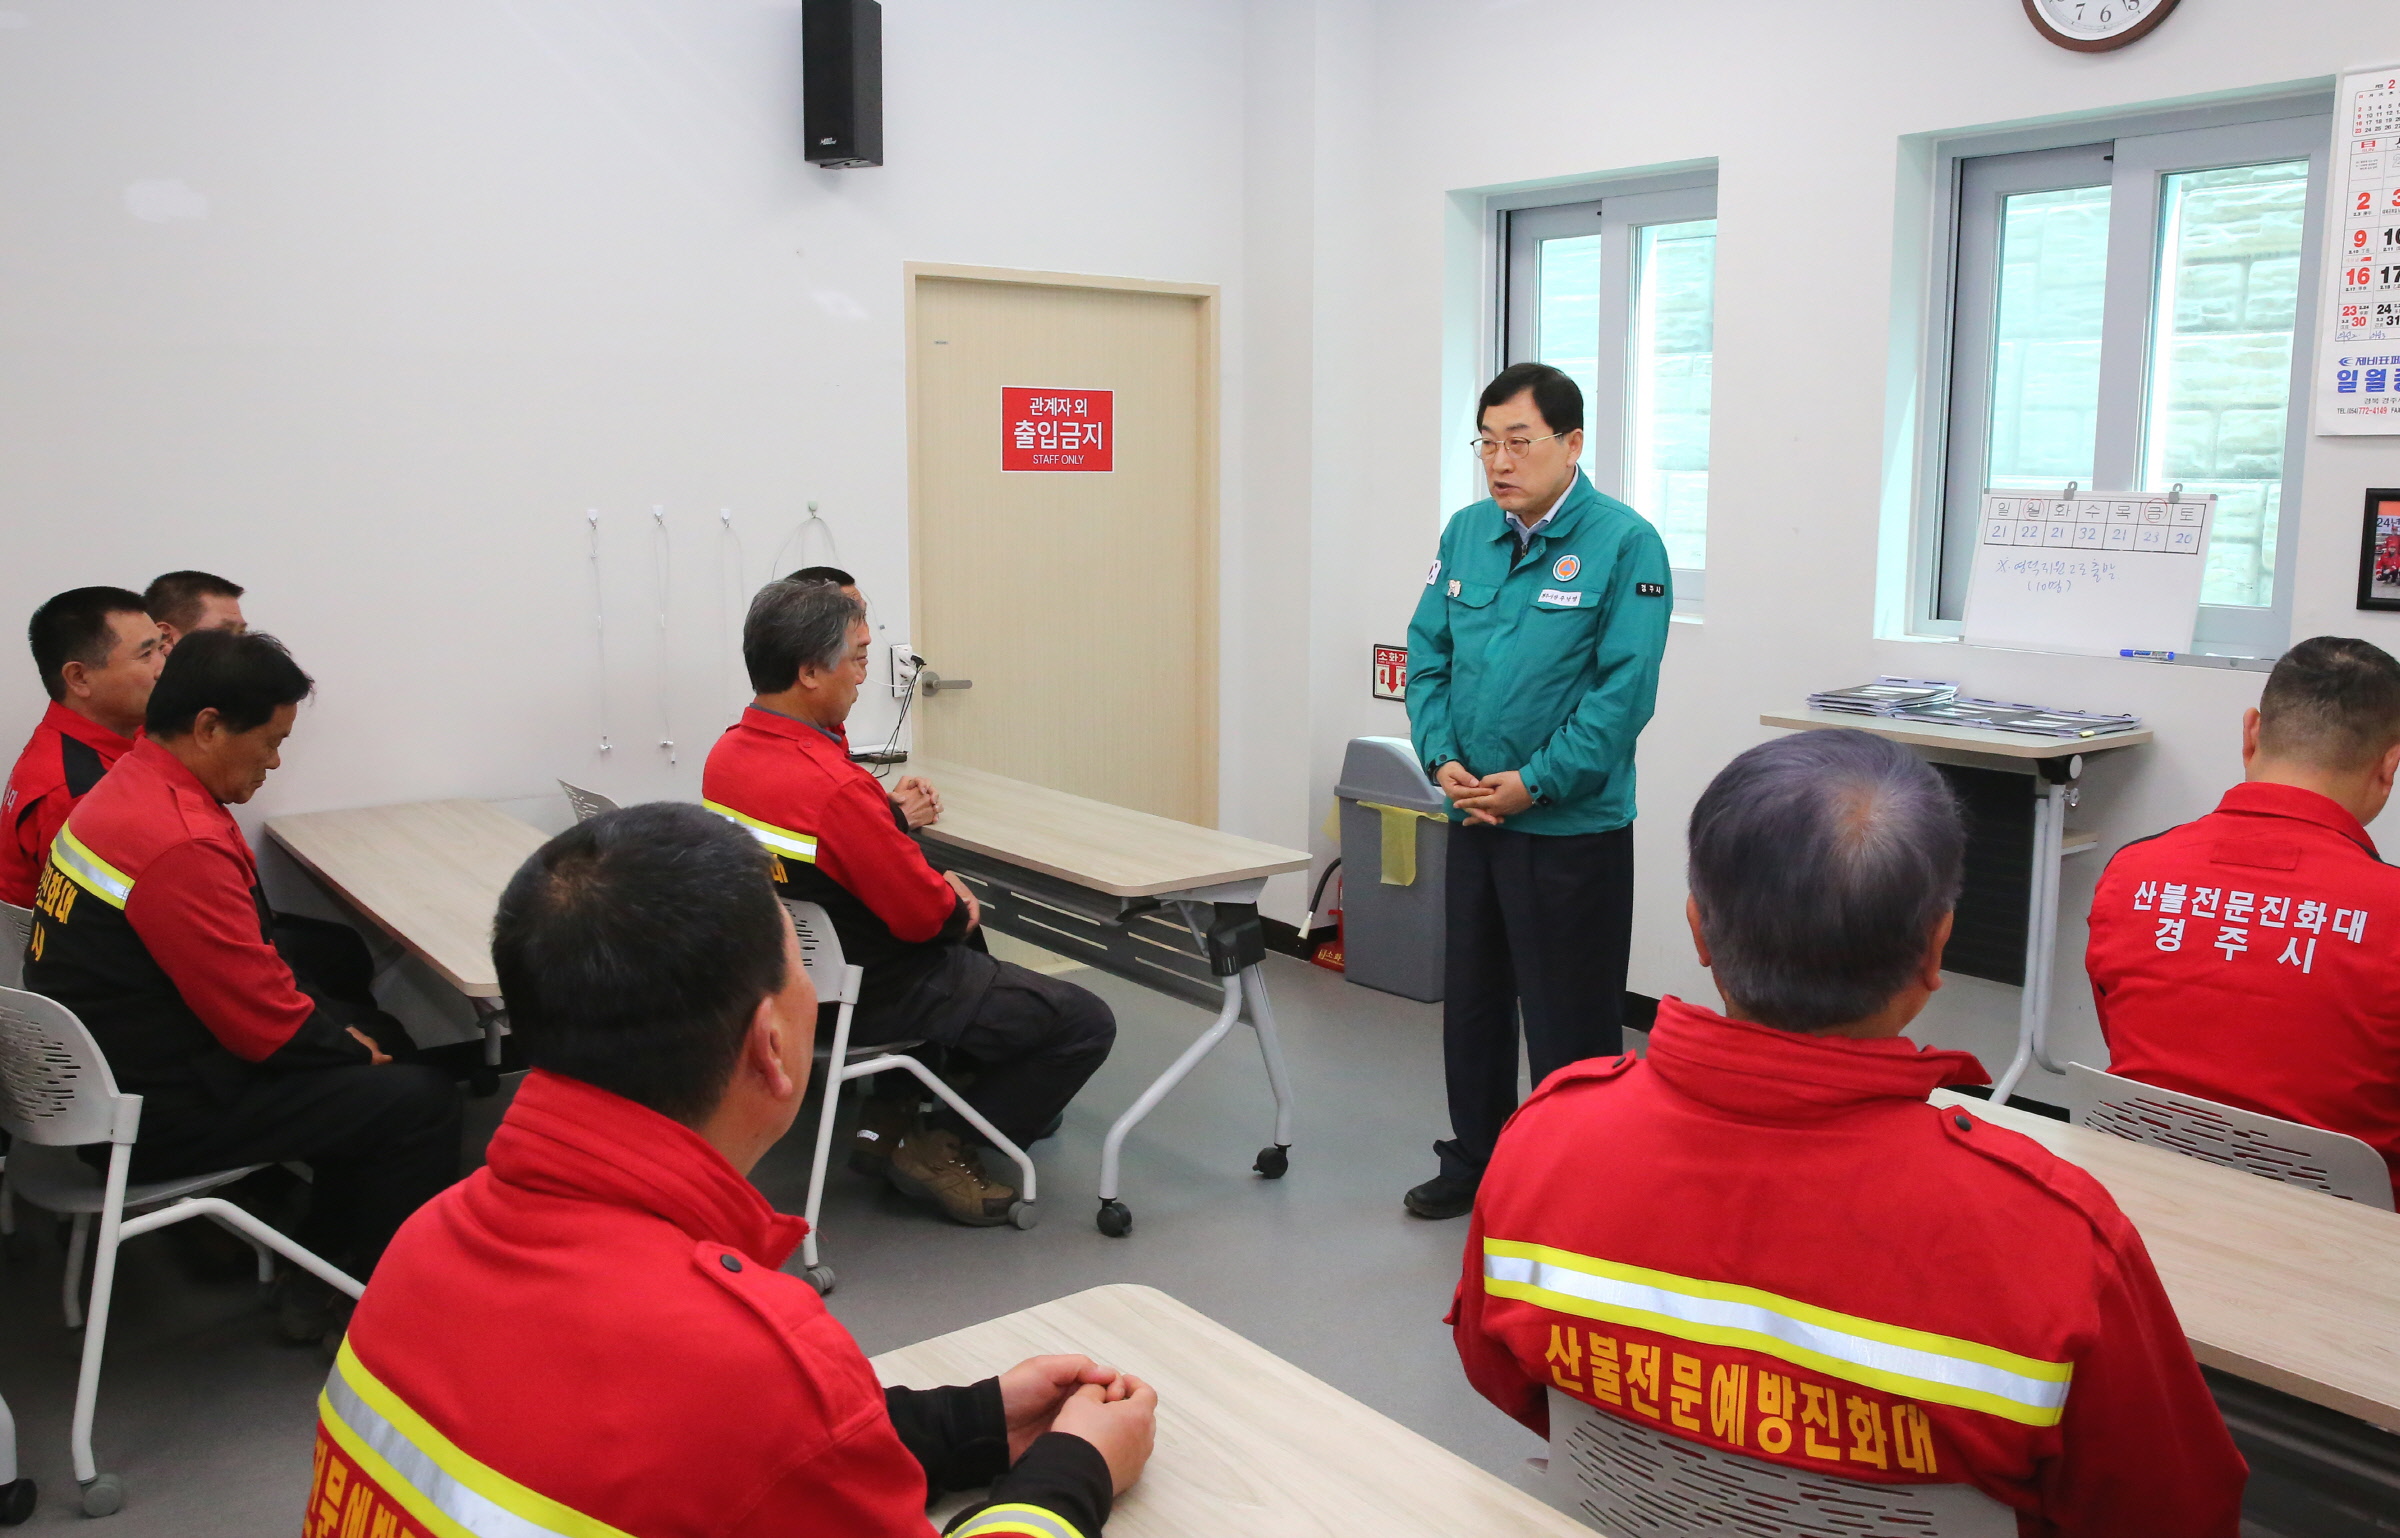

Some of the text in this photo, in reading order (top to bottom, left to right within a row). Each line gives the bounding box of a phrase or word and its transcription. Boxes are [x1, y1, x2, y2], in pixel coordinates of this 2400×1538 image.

[2075, 3, 2086, 20] 7
[2100, 4, 2112, 23] 6
[2388, 79, 2396, 89] 2
[2357, 192, 2371, 210] 2
[2354, 229, 2367, 248] 9
[2346, 266, 2400, 285] 16 17
[2342, 305, 2357, 316] 23
[2377, 304, 2392, 315] 24
[2352, 316, 2367, 327] 30
[2386, 315, 2400, 326] 31
[1030, 397, 1087, 417] 관계자 외
[1013, 420, 1102, 450] 출입금지
[1033, 454, 1084, 465] STAFF ONLY
[1998, 502, 2195, 521] 일 월 화 수 목 금 토
[1992, 525, 2193, 544] 21 22 21 32 21 23 20
[1378, 651, 1407, 663] 소화기
[2133, 880, 2368, 944] 산불전문진화대
[1545, 1323, 1938, 1474] 산불전문예방진화대
